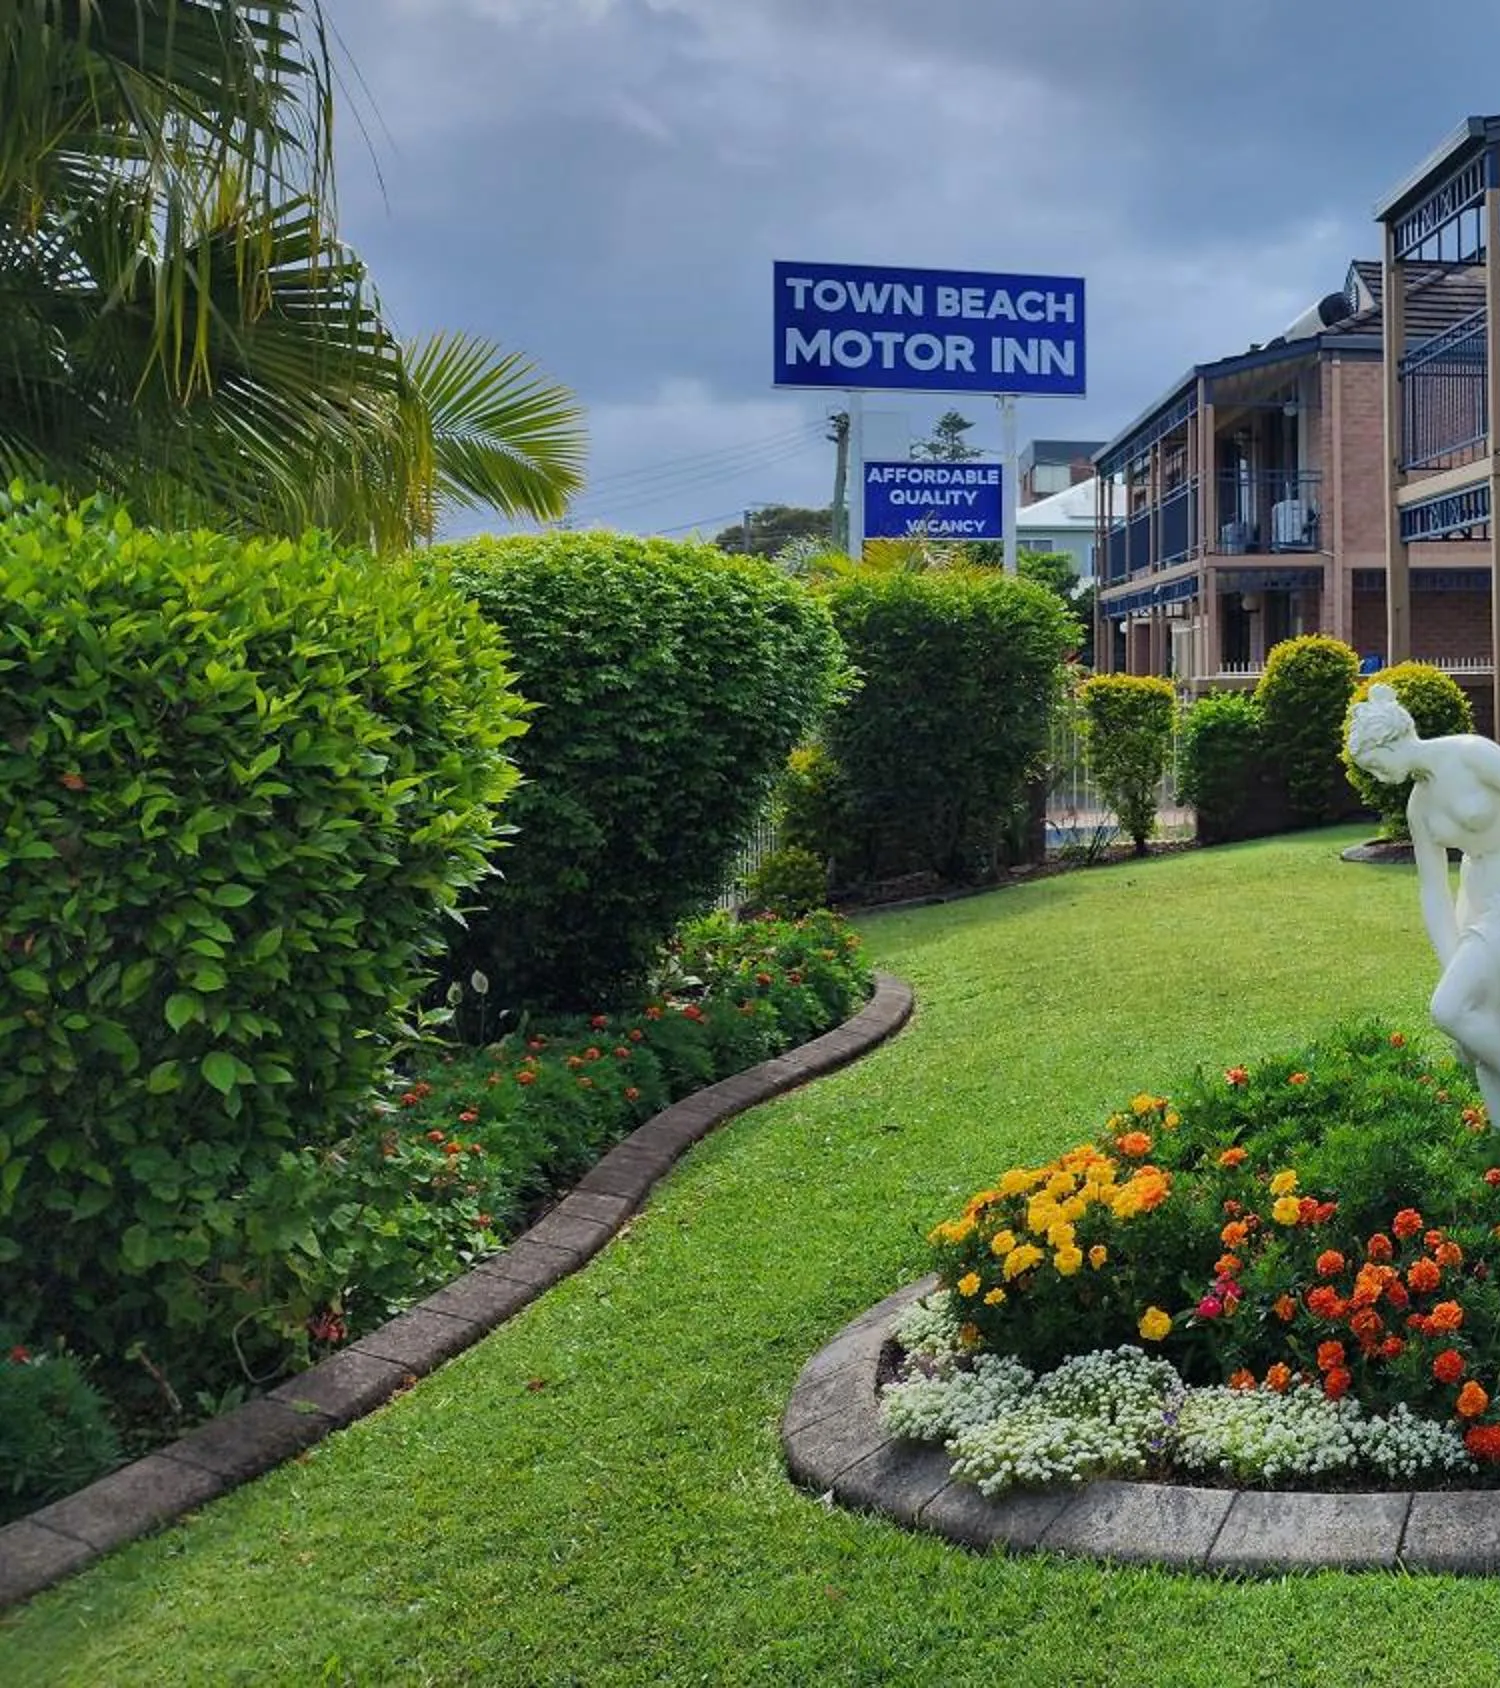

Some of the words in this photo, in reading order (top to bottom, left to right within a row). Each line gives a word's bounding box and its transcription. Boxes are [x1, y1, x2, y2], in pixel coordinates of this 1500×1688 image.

[785, 277, 924, 316] TOWN
[937, 286, 1075, 323] BEACH
[785, 327, 976, 372] MOTOR
[991, 336, 1075, 377] INN
[867, 467, 999, 485] AFFORDABLE
[889, 489, 978, 505] QUALITY
[906, 519, 986, 533] VACANCY
